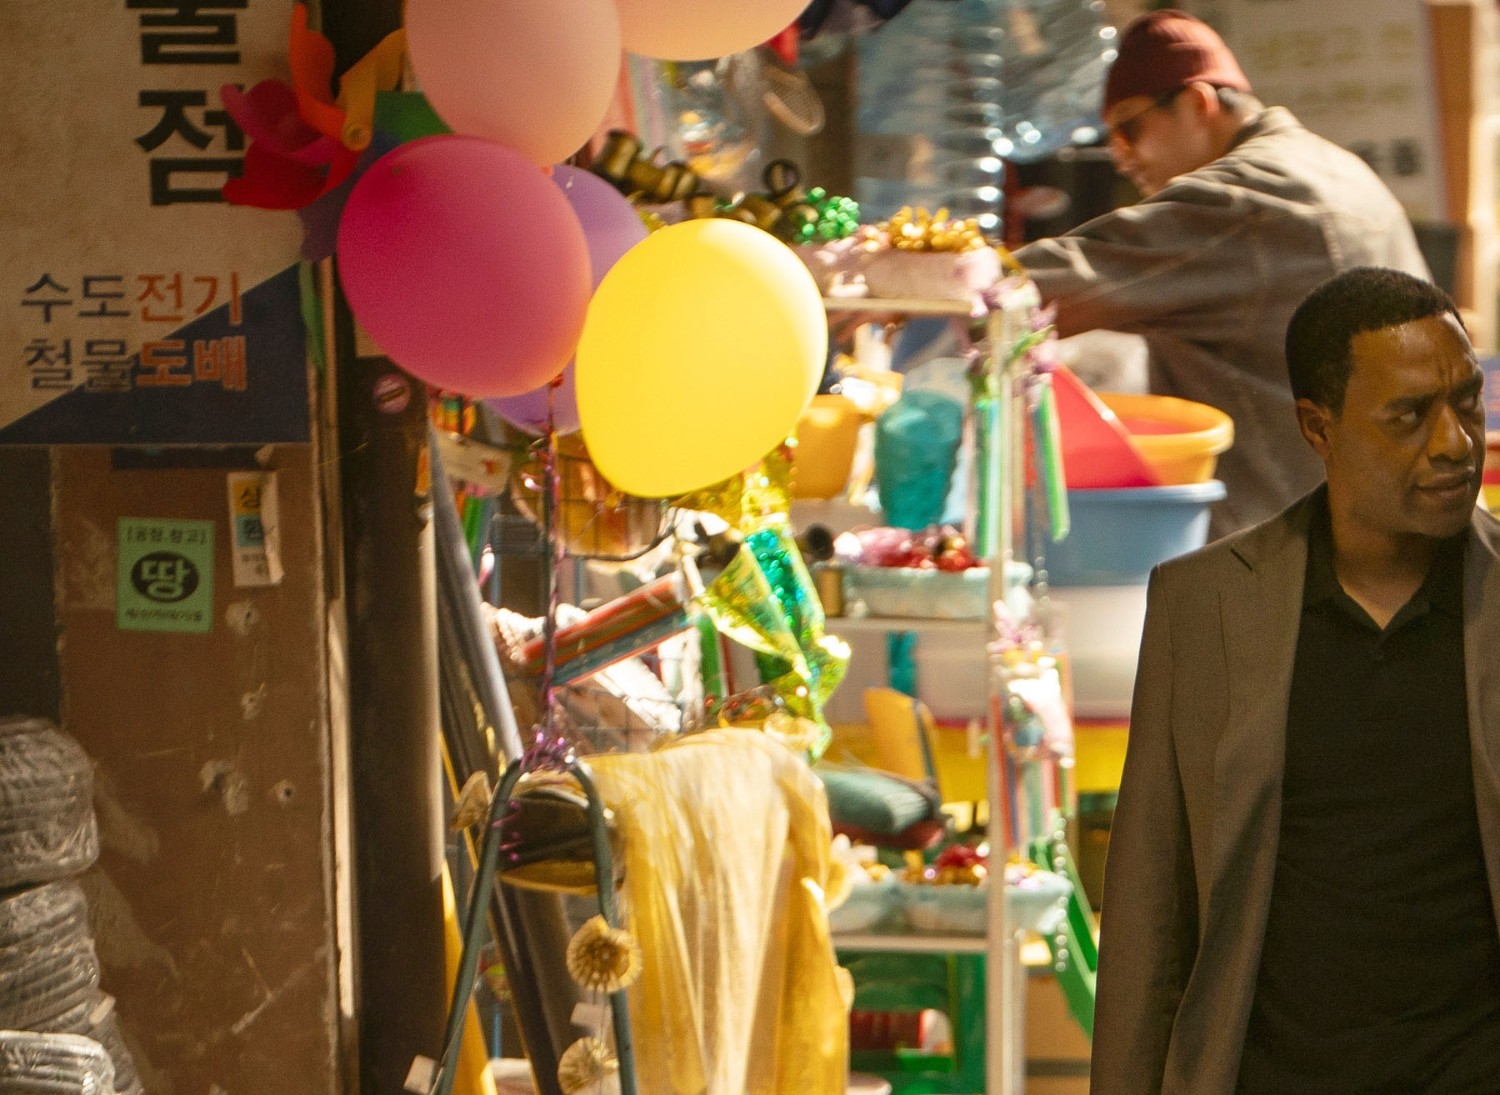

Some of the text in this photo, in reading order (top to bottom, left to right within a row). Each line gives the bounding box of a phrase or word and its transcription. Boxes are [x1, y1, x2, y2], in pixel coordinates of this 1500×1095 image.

[21, 271, 243, 327] 수도전기
[24, 335, 248, 392] 철물도배
[141, 559, 192, 599] 땅
